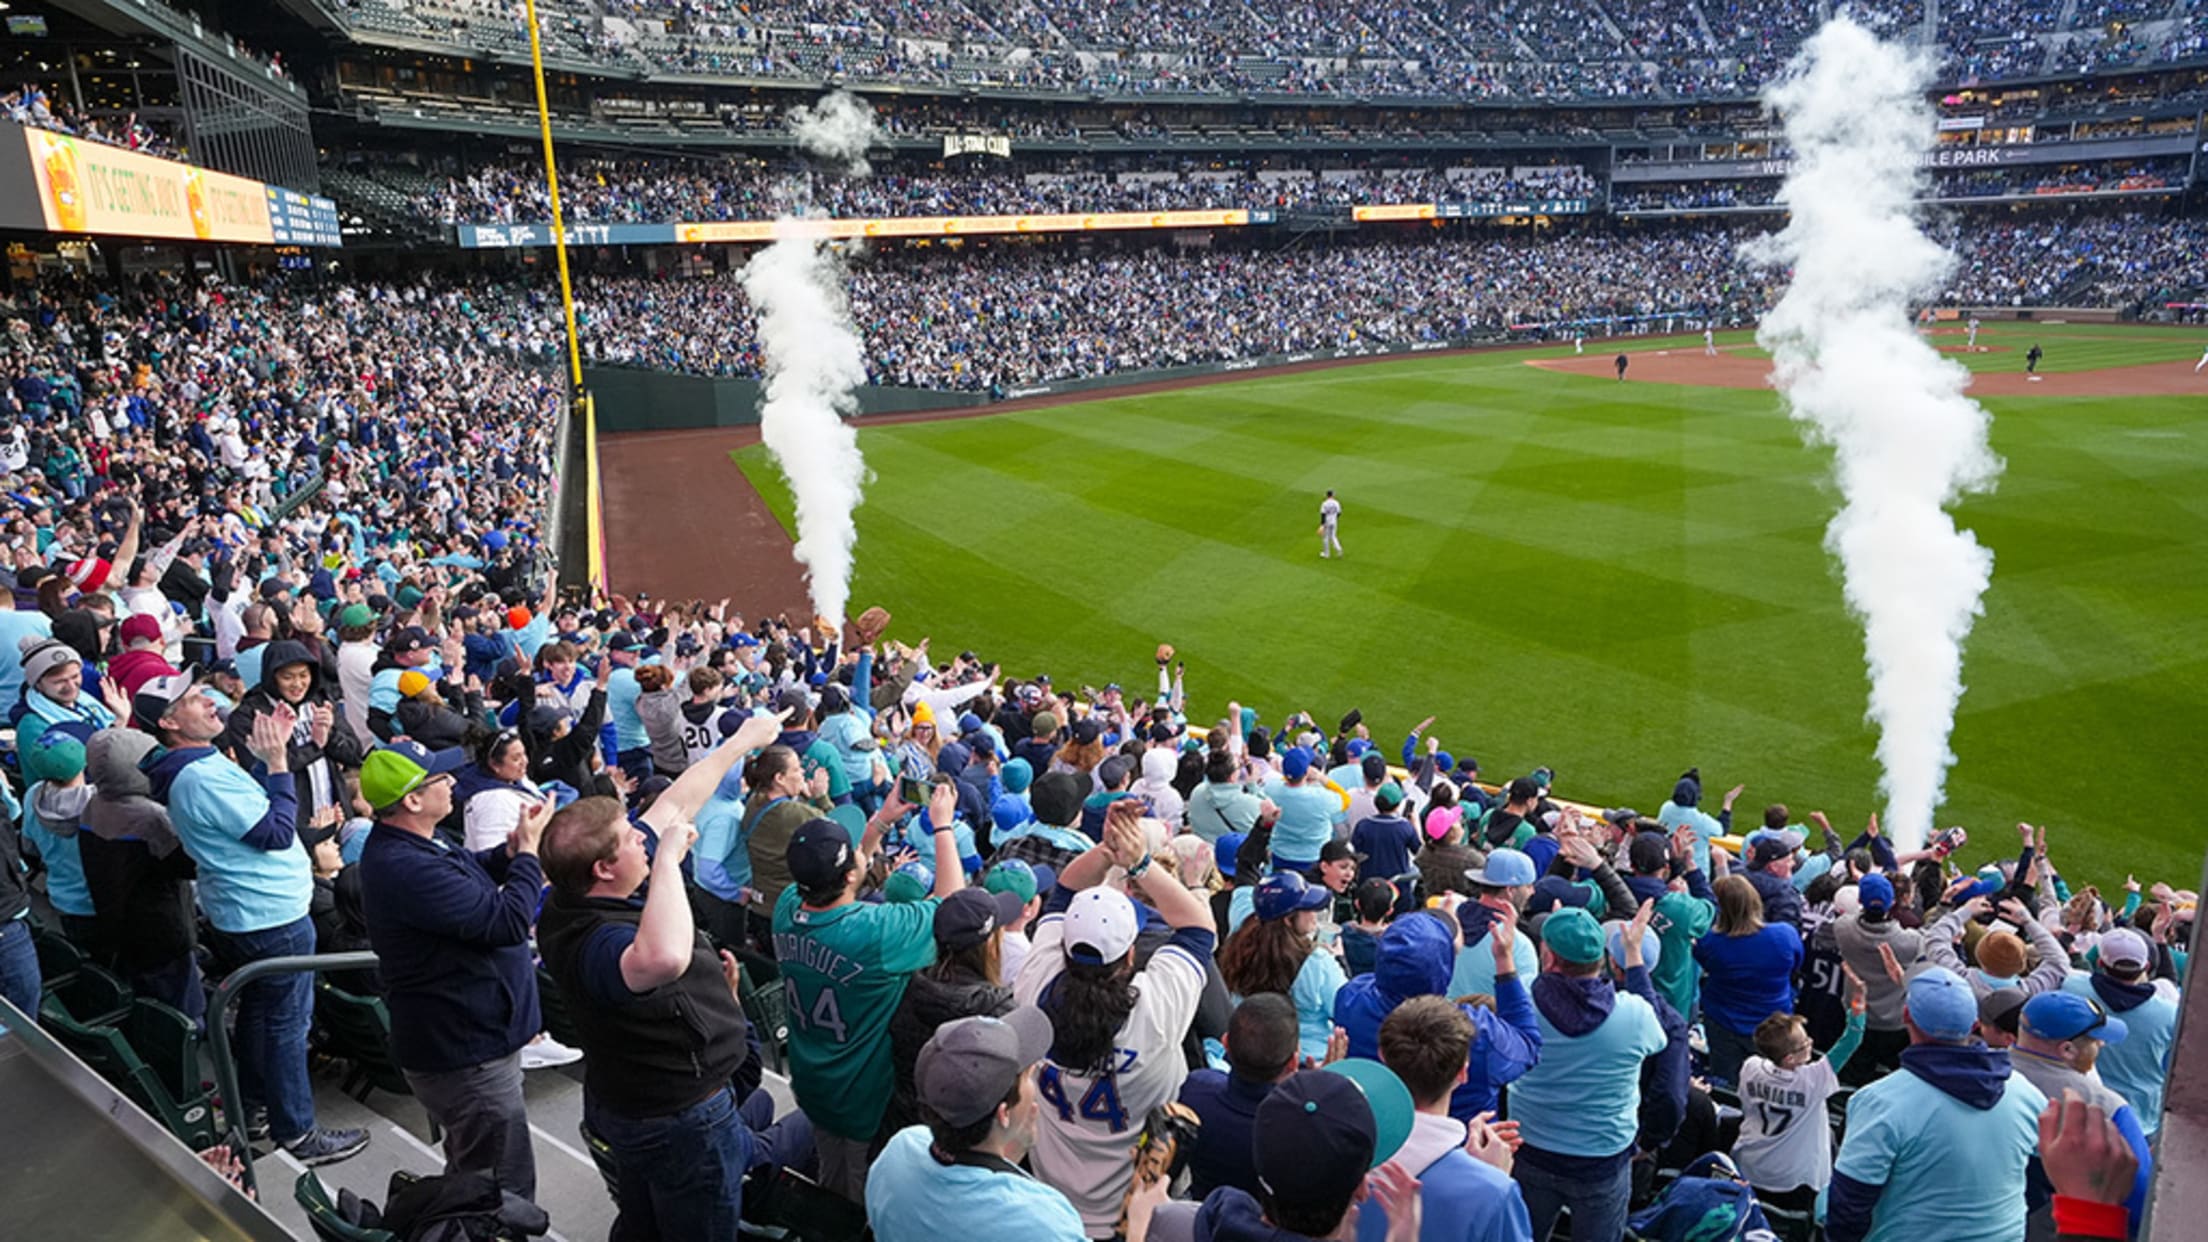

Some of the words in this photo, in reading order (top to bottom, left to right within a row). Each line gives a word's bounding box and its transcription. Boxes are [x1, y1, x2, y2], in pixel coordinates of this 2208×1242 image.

[943, 134, 986, 158] ALL-STAR
[986, 134, 1011, 158] CLUB
[1953, 148, 2001, 166] PARK
[685, 726, 712, 749] 20
[1812, 958, 1840, 995] 51
[784, 976, 847, 1043] 44
[1038, 1062, 1129, 1135] 44
[1758, 1102, 1793, 1137] 17
